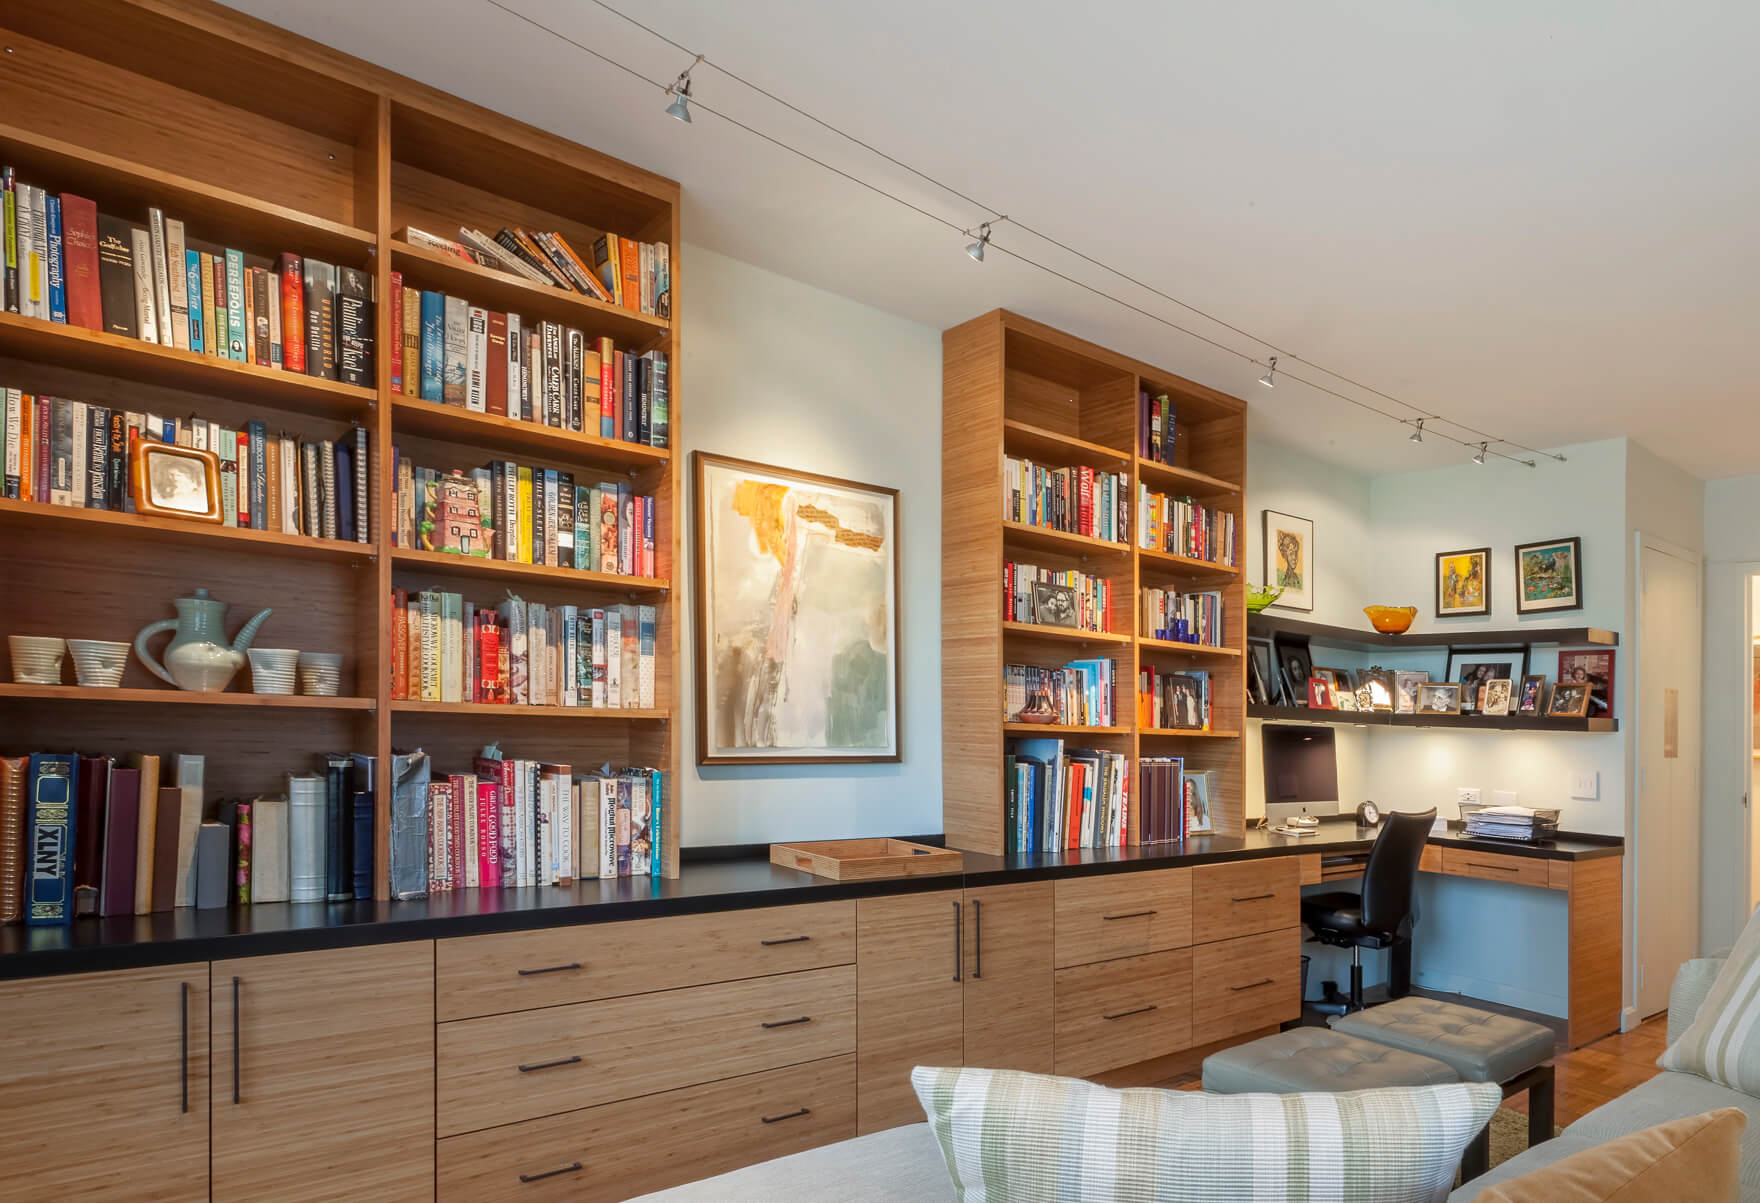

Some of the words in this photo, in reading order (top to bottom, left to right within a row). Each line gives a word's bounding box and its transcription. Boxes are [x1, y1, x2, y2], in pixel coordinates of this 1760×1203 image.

[49, 235, 62, 288] Photography
[228, 254, 241, 327] PERSEPOLIS
[310, 310, 320, 323] Don
[343, 297, 363, 335] Pauline
[310, 326, 320, 351] DeLillo
[321, 299, 332, 369] UNDERWORLD
[343, 348, 363, 372] Kael
[552, 367, 561, 391] CALEB
[8, 391, 20, 414] How
[552, 392, 561, 413] CARR
[8, 415, 20, 430] We
[7, 432, 19, 448] Die
[1081, 471, 1090, 497] Wolf
[488, 815, 497, 839] GOOD
[36, 829, 60, 879] XLNY
[489, 840, 497, 864] FOOD
[608, 827, 617, 867] Microwave
